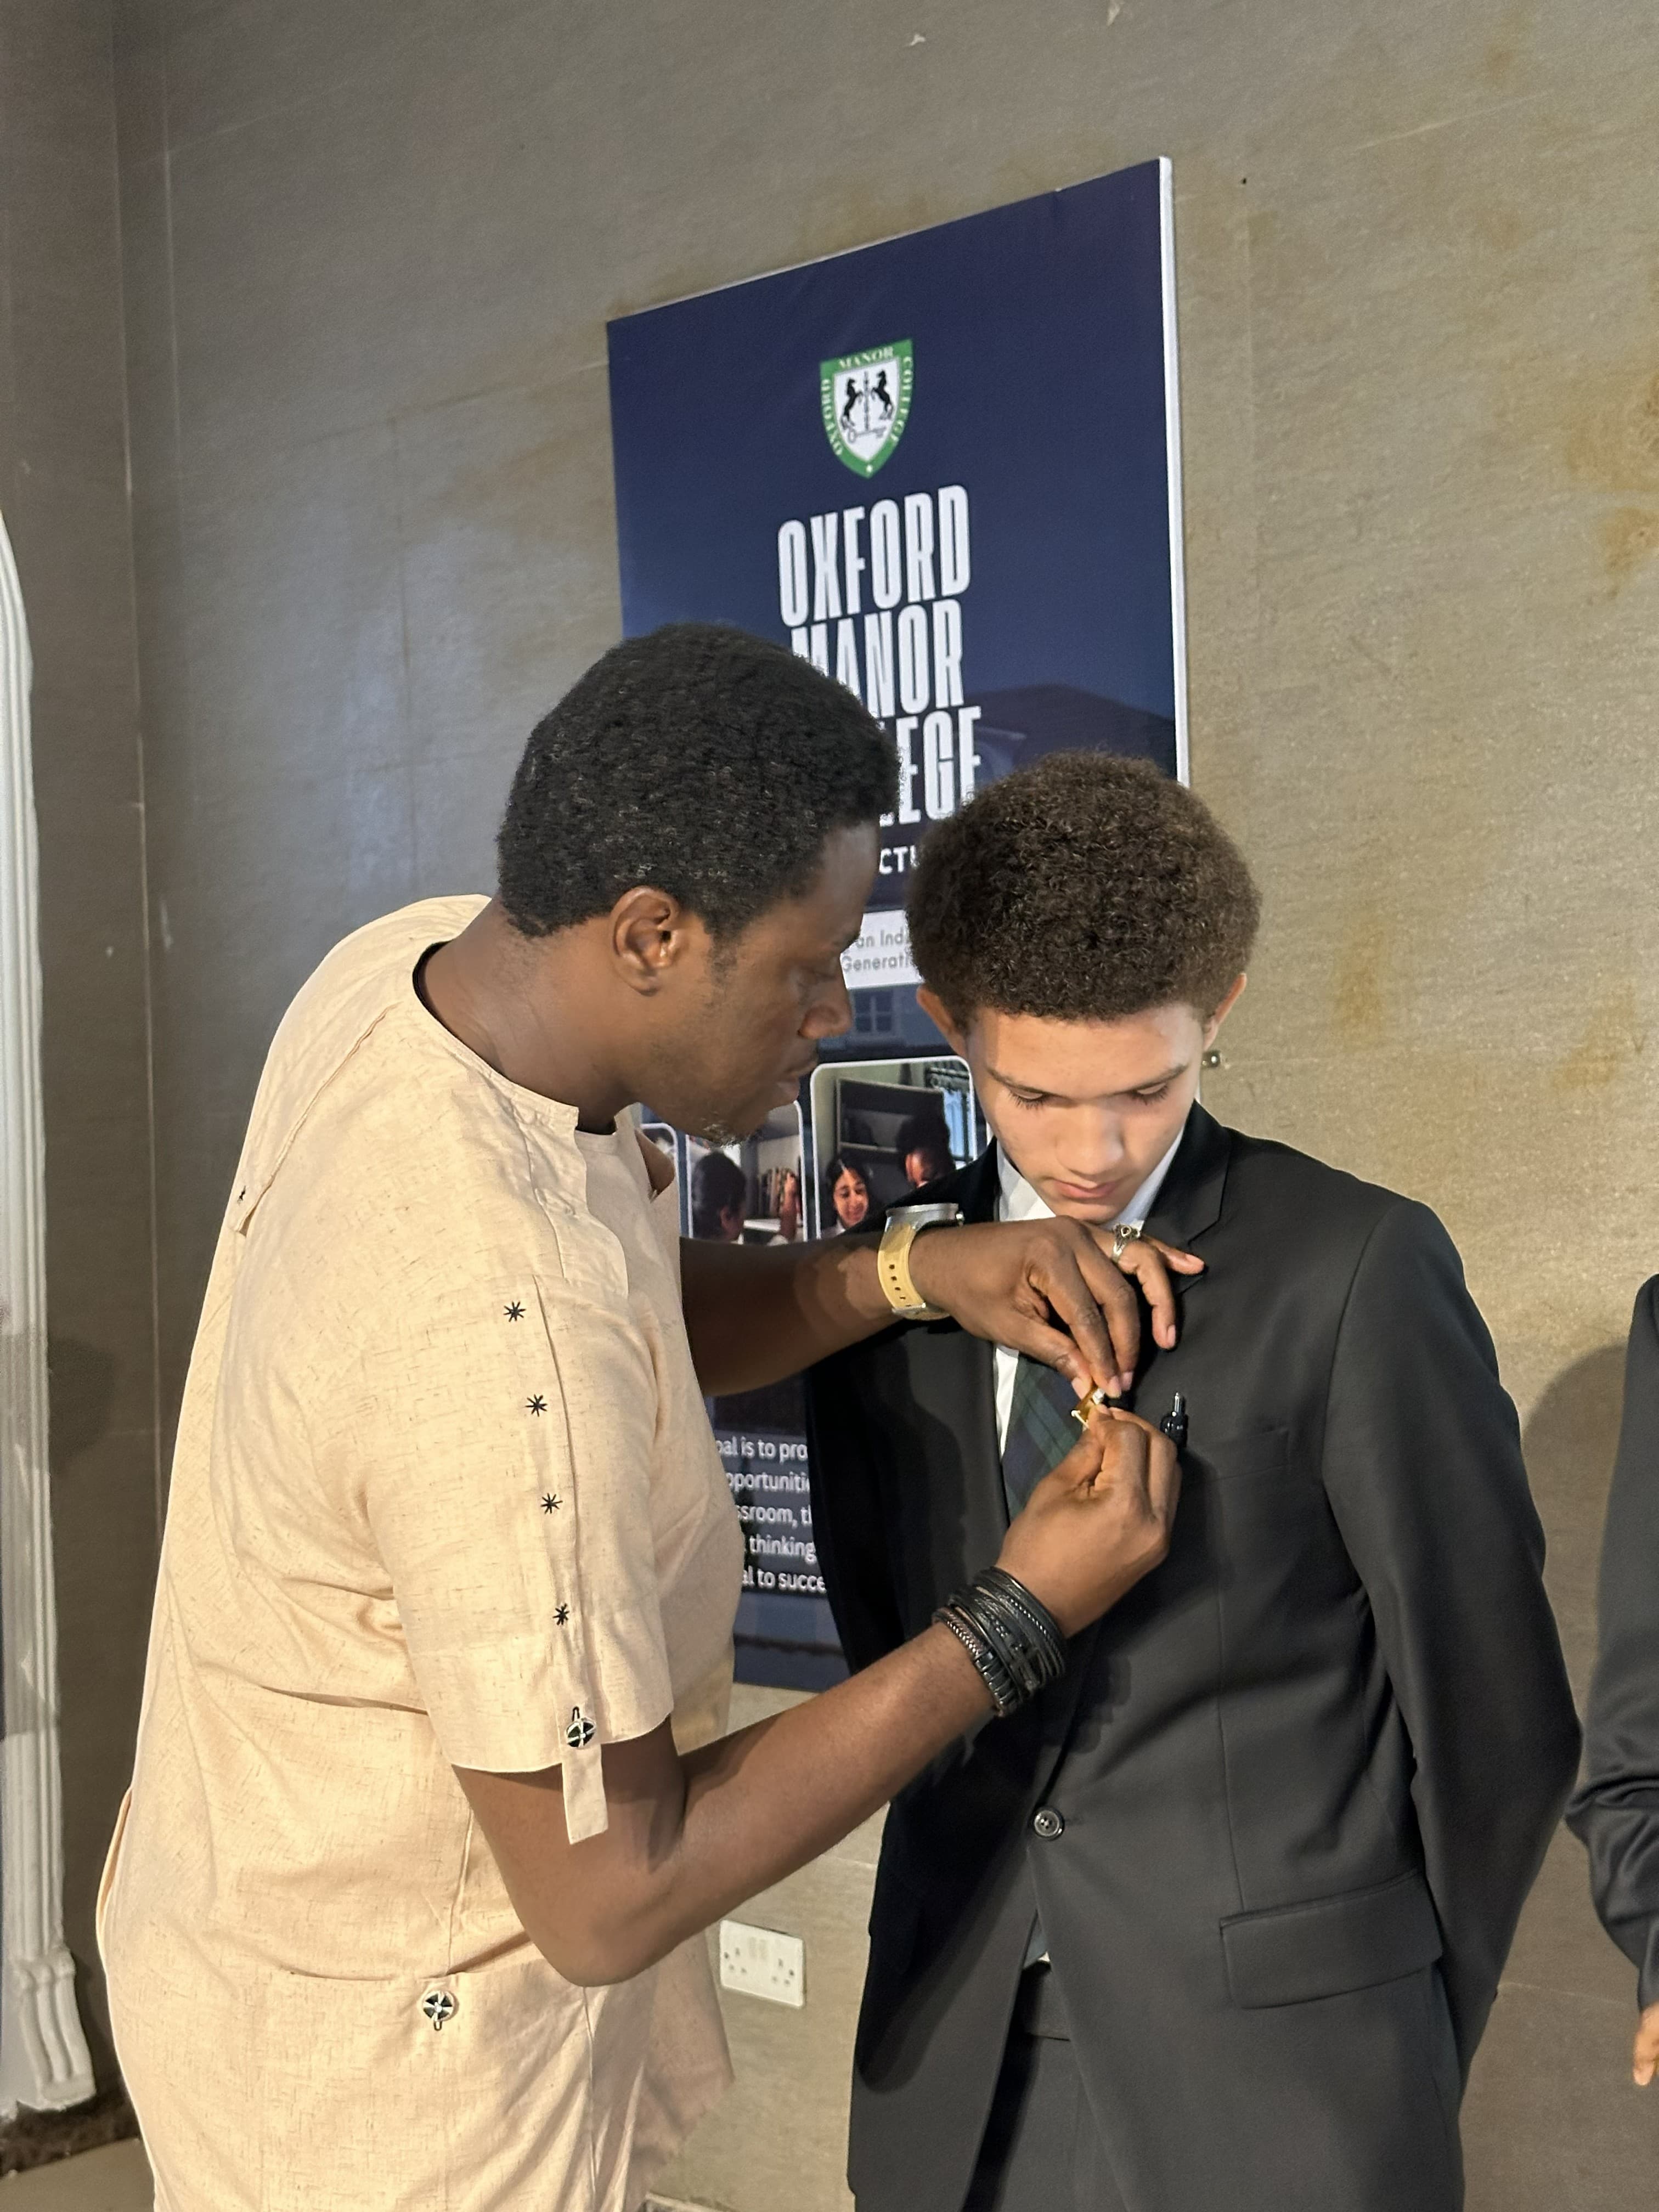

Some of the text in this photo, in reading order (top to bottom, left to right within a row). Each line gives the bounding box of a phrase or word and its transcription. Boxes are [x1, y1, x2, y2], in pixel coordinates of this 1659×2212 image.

[777, 484, 971, 628] OXFORD
[880, 926, 909, 947] Ind
[842, 953, 910, 972] Generati
[741, 1436, 755, 1459] is
[758, 1439, 776, 1459] to
[779, 1443, 808, 1465] pro
[749, 1533, 817, 1566] thinking
[758, 1567, 776, 1589] to
